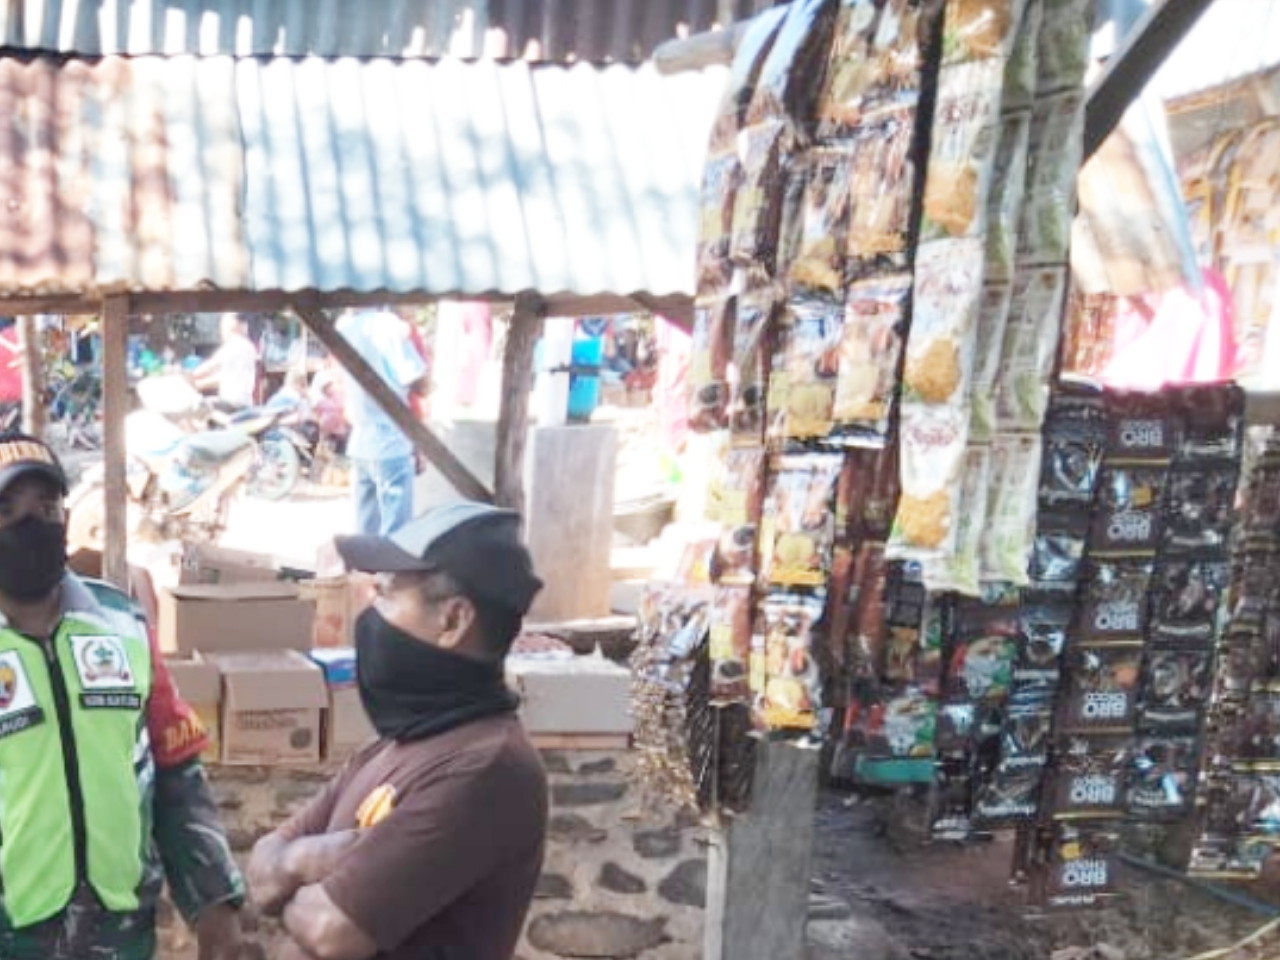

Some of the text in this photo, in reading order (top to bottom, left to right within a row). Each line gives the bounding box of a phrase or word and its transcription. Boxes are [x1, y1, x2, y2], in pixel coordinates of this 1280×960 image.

[1121, 431, 1163, 446] BRO
[1108, 524, 1150, 539] BRO
[1095, 614, 1138, 629] BRO
[1084, 702, 1126, 717] BRO
[1071, 786, 1115, 802] BRO
[1063, 871, 1106, 884] BRO
